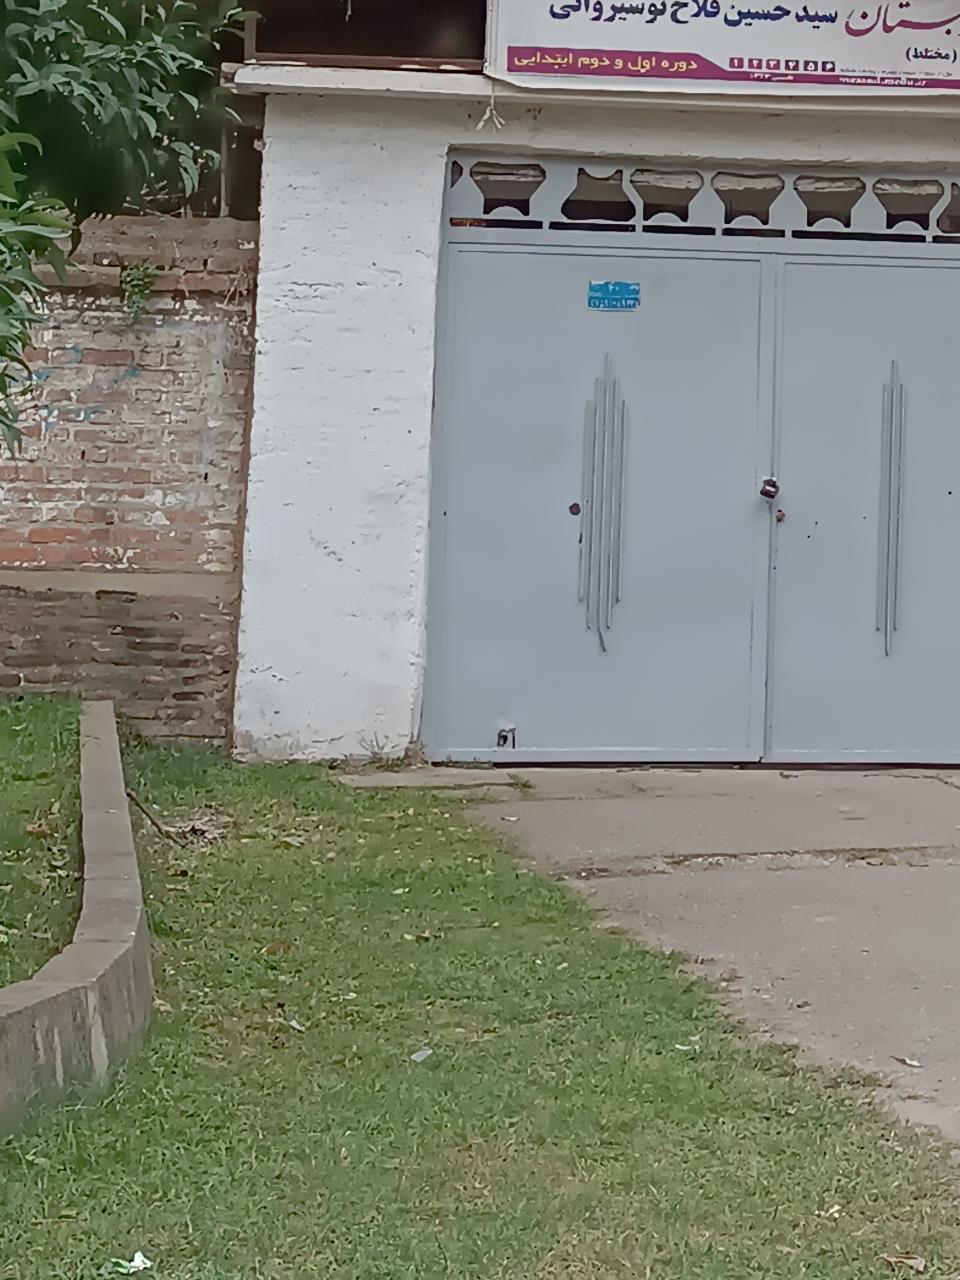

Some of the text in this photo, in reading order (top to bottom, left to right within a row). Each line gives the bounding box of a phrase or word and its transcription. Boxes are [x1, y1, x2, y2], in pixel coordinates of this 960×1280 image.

[723, 4, 792, 28] حسین
[794, 4, 838, 29] سید
[514, 51, 699, 73] دوره اول و دوم ابتدایی
